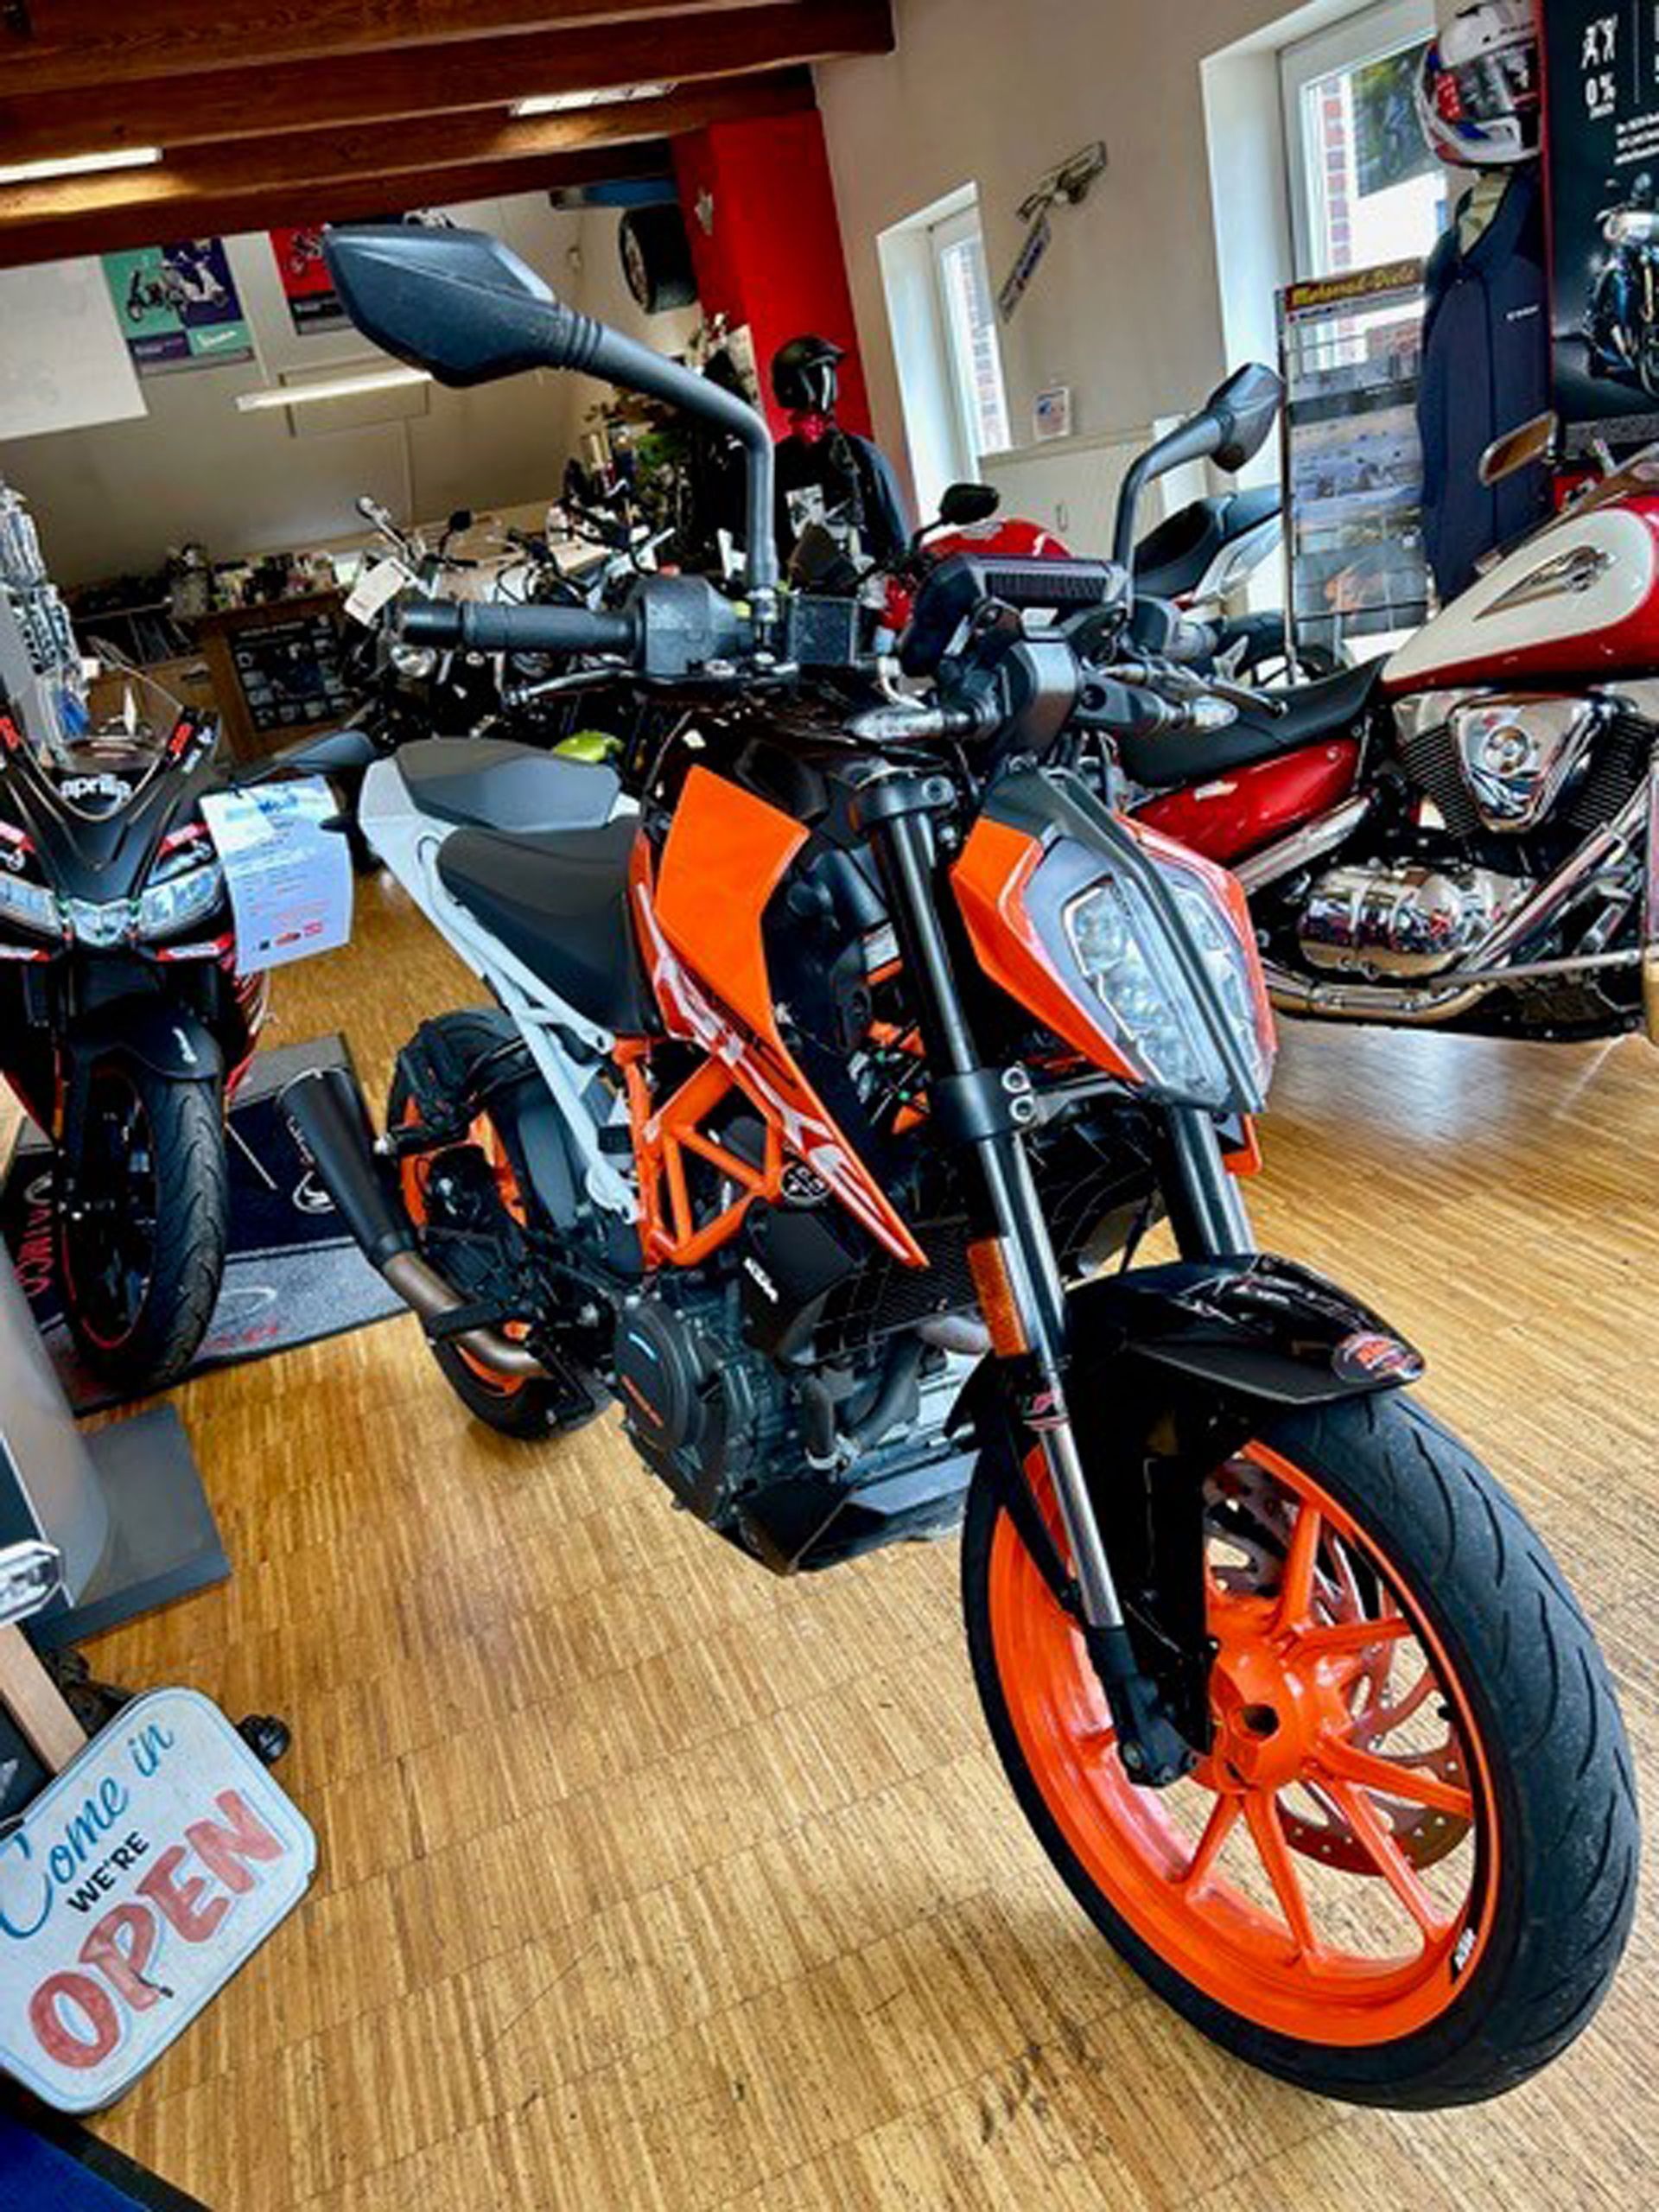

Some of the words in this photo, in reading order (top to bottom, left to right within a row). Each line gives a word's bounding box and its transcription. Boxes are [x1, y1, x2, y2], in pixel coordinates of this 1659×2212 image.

[0, 1776, 129, 1939] Come
[128, 1724, 175, 1778] in
[29, 1789, 284, 2069] OPEN
[66, 1830, 150, 1914] WE'RE
